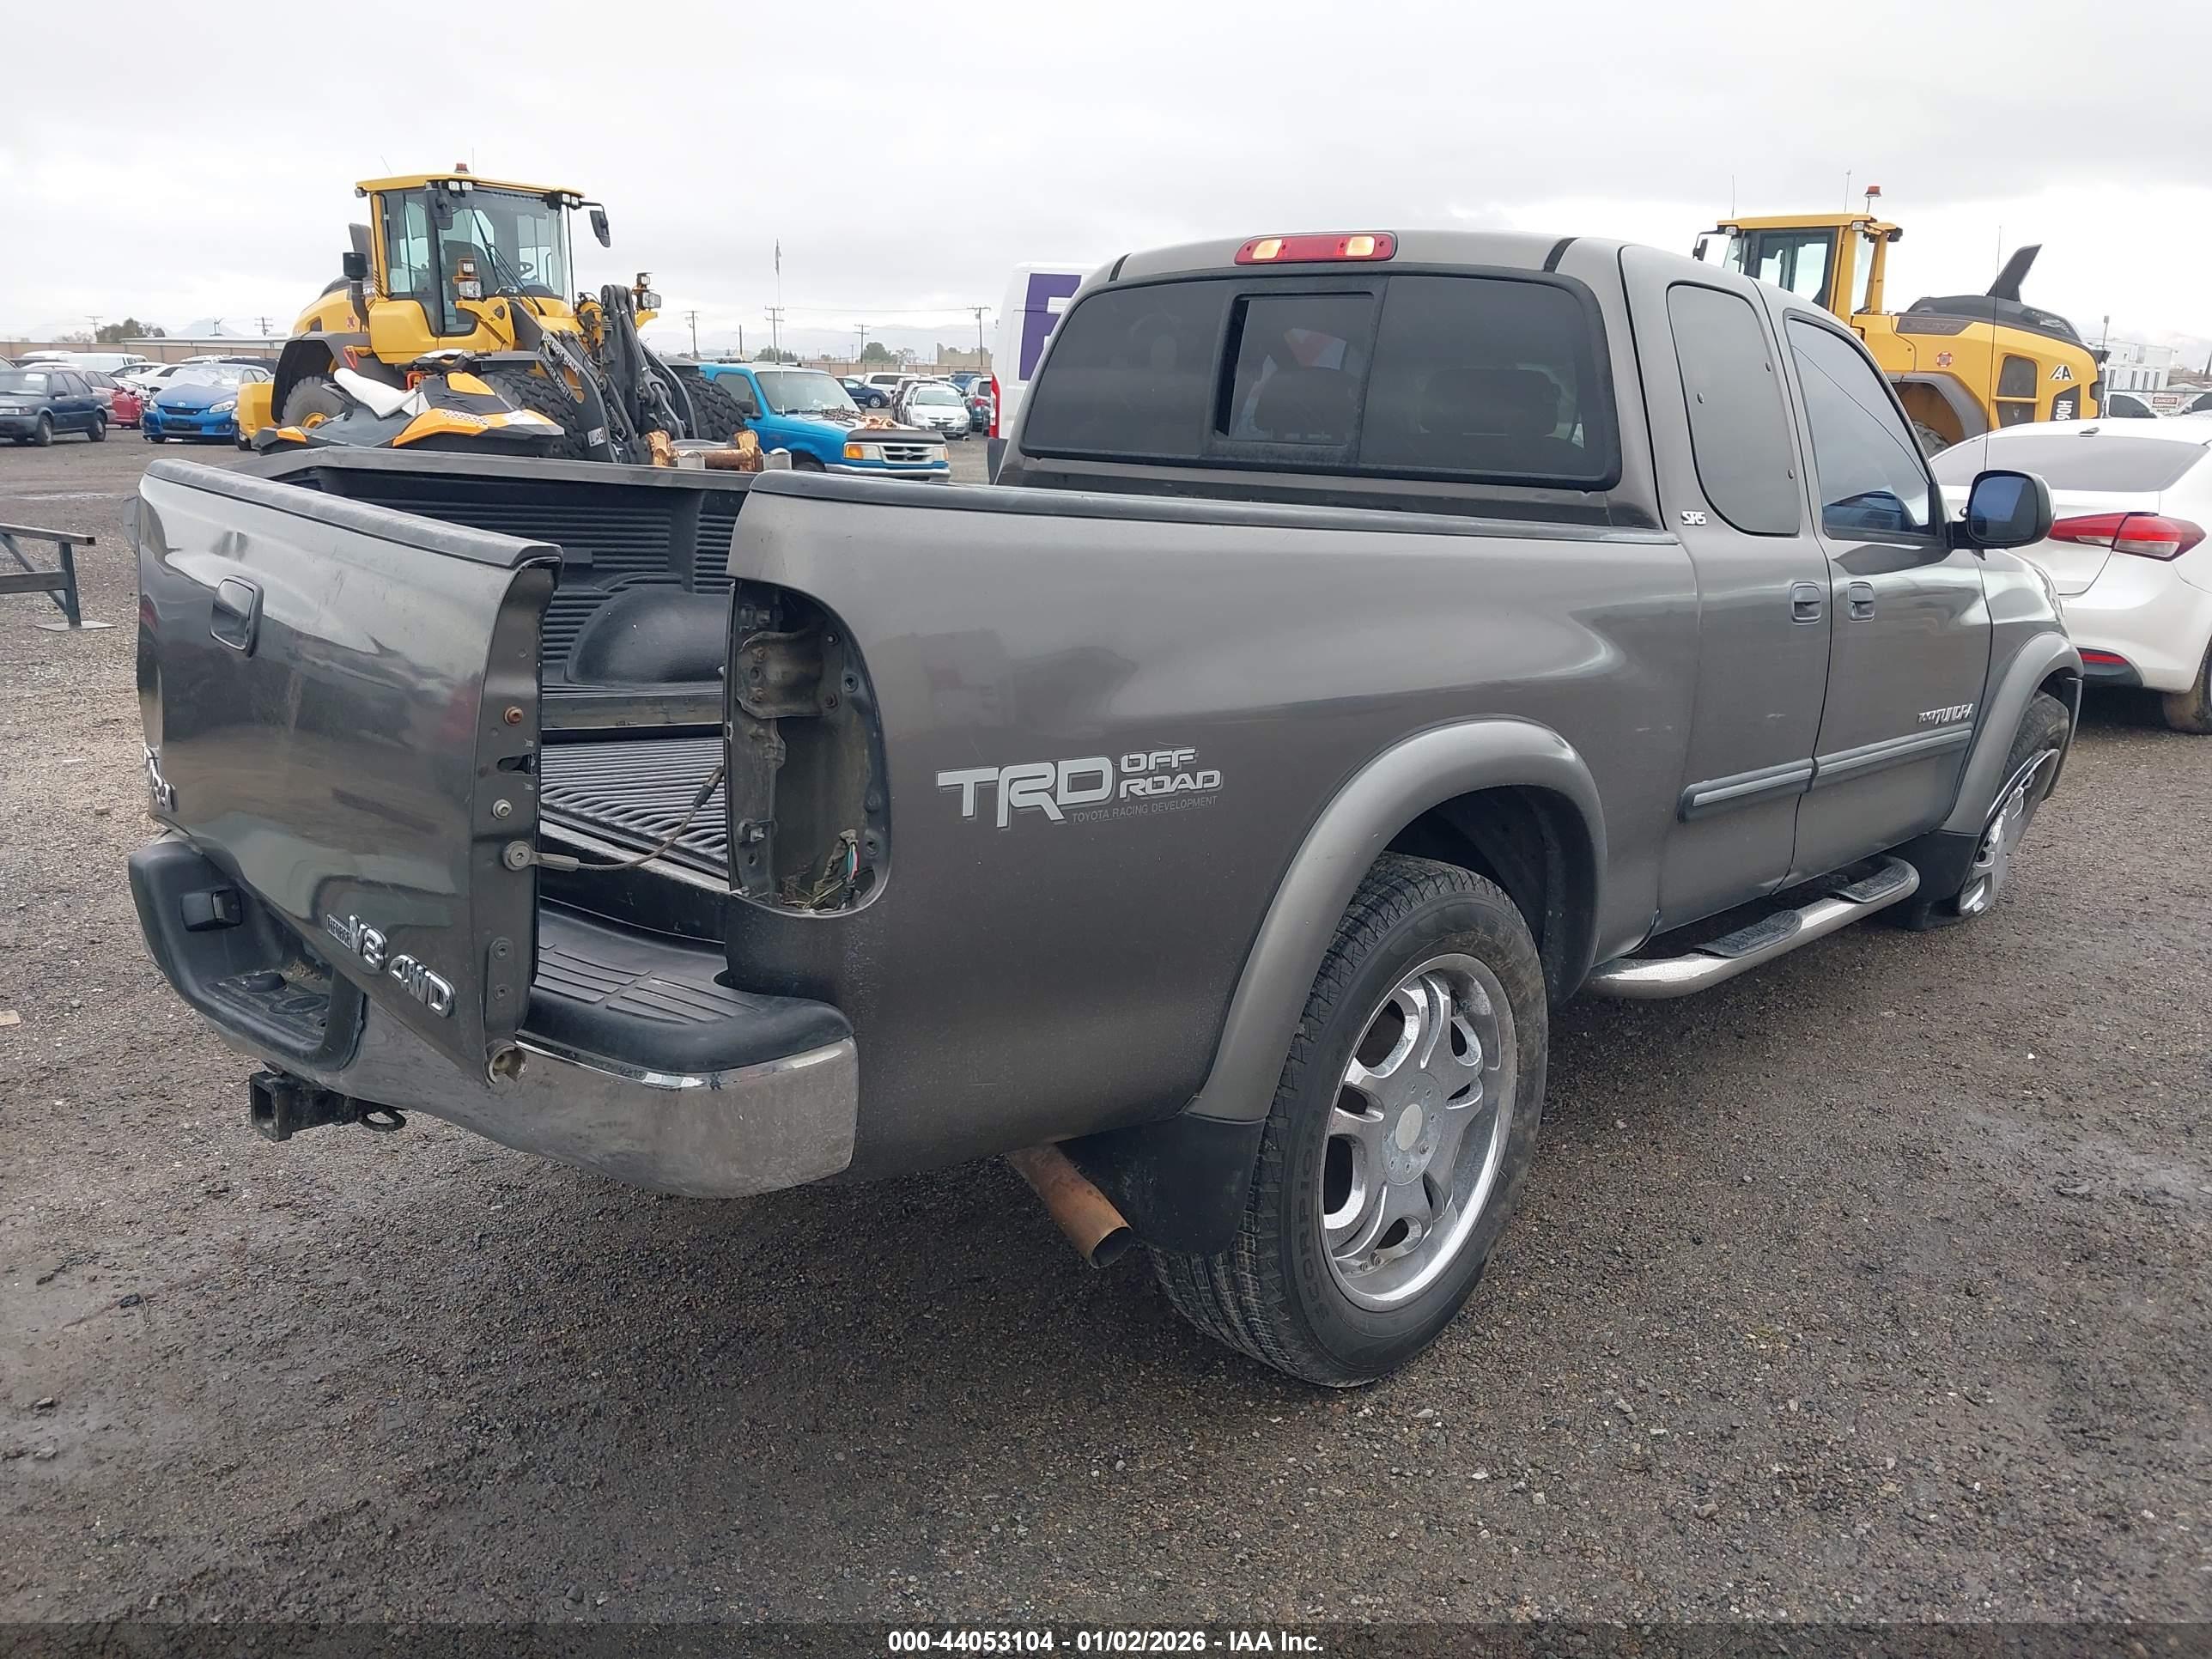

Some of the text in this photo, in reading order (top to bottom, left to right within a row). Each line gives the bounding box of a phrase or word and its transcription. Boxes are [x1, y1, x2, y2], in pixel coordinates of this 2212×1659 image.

[1681, 511, 1707, 526] SR5
[937, 747, 1199, 830] TRD OFF
[1119, 769, 1224, 802] ROAD
[1071, 795, 1218, 824] TOYOTA RACING DEVELOPMENT
[349, 914, 386, 970] V8
[388, 954, 455, 1018] 4WD
